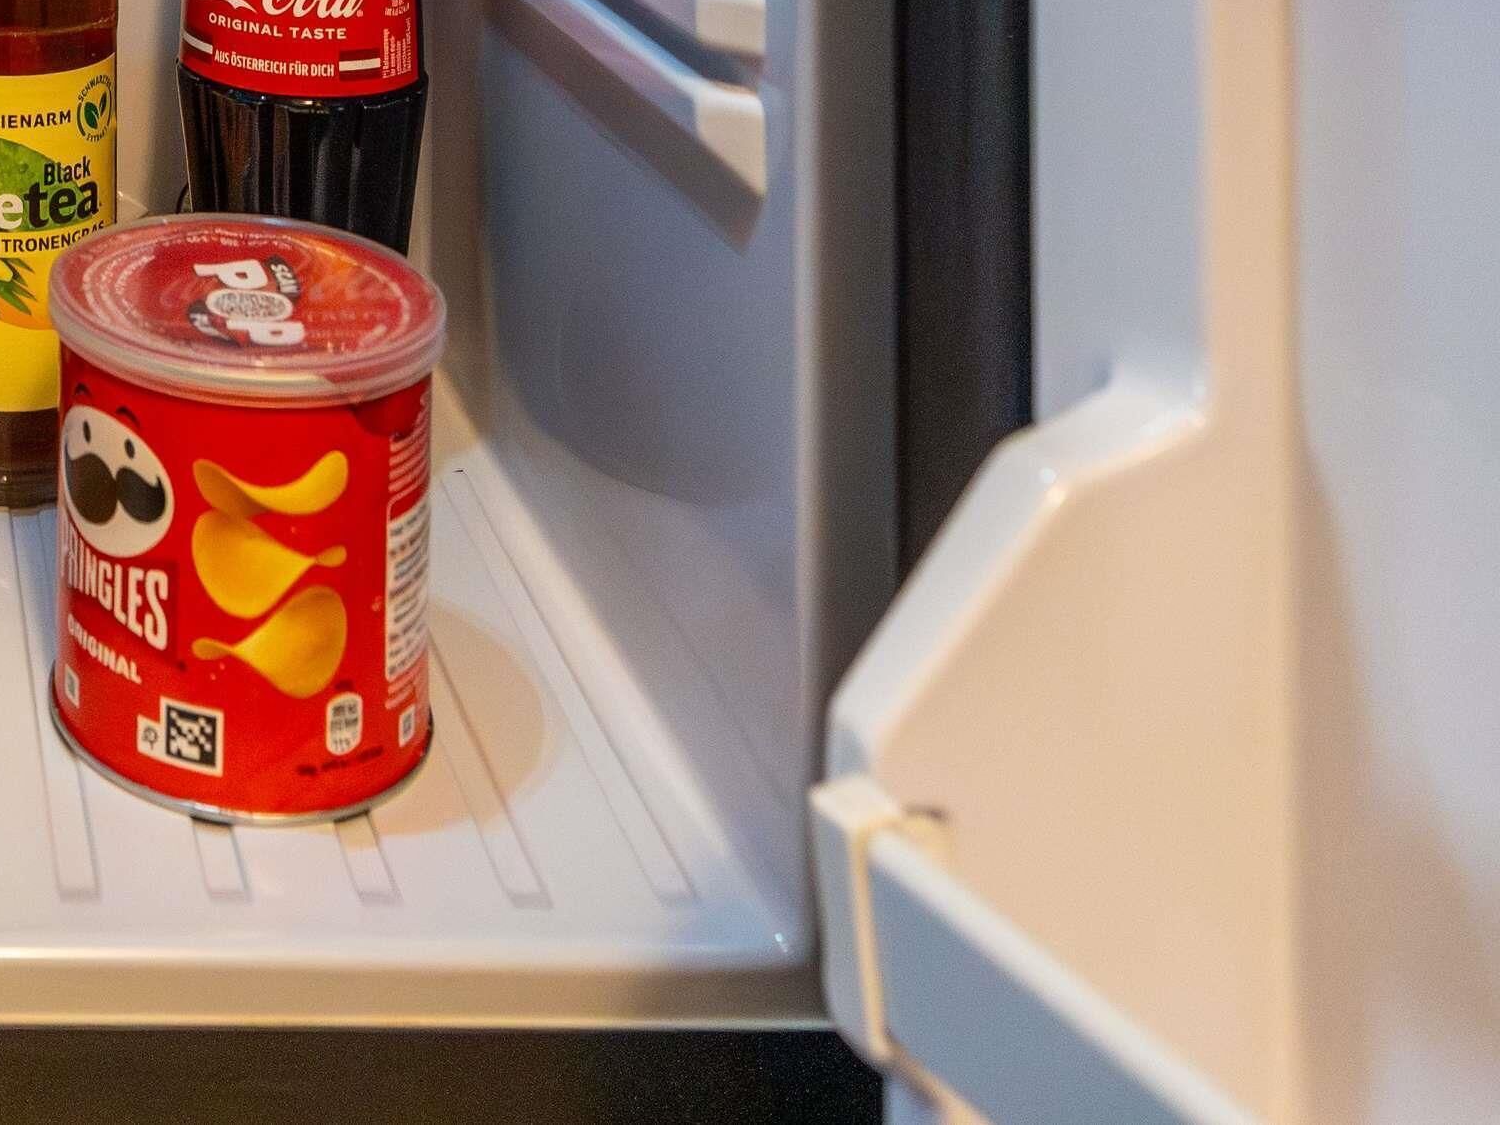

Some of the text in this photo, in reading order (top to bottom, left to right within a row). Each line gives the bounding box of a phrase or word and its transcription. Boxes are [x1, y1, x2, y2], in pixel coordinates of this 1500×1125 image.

[208, 13, 347, 40] ORIGINAL TASTE
[214, 49, 334, 77] AUS ÖSTERREICH FÜR DICH
[43, 156, 91, 187] Black
[67, 613, 142, 684] ORIGINAL
